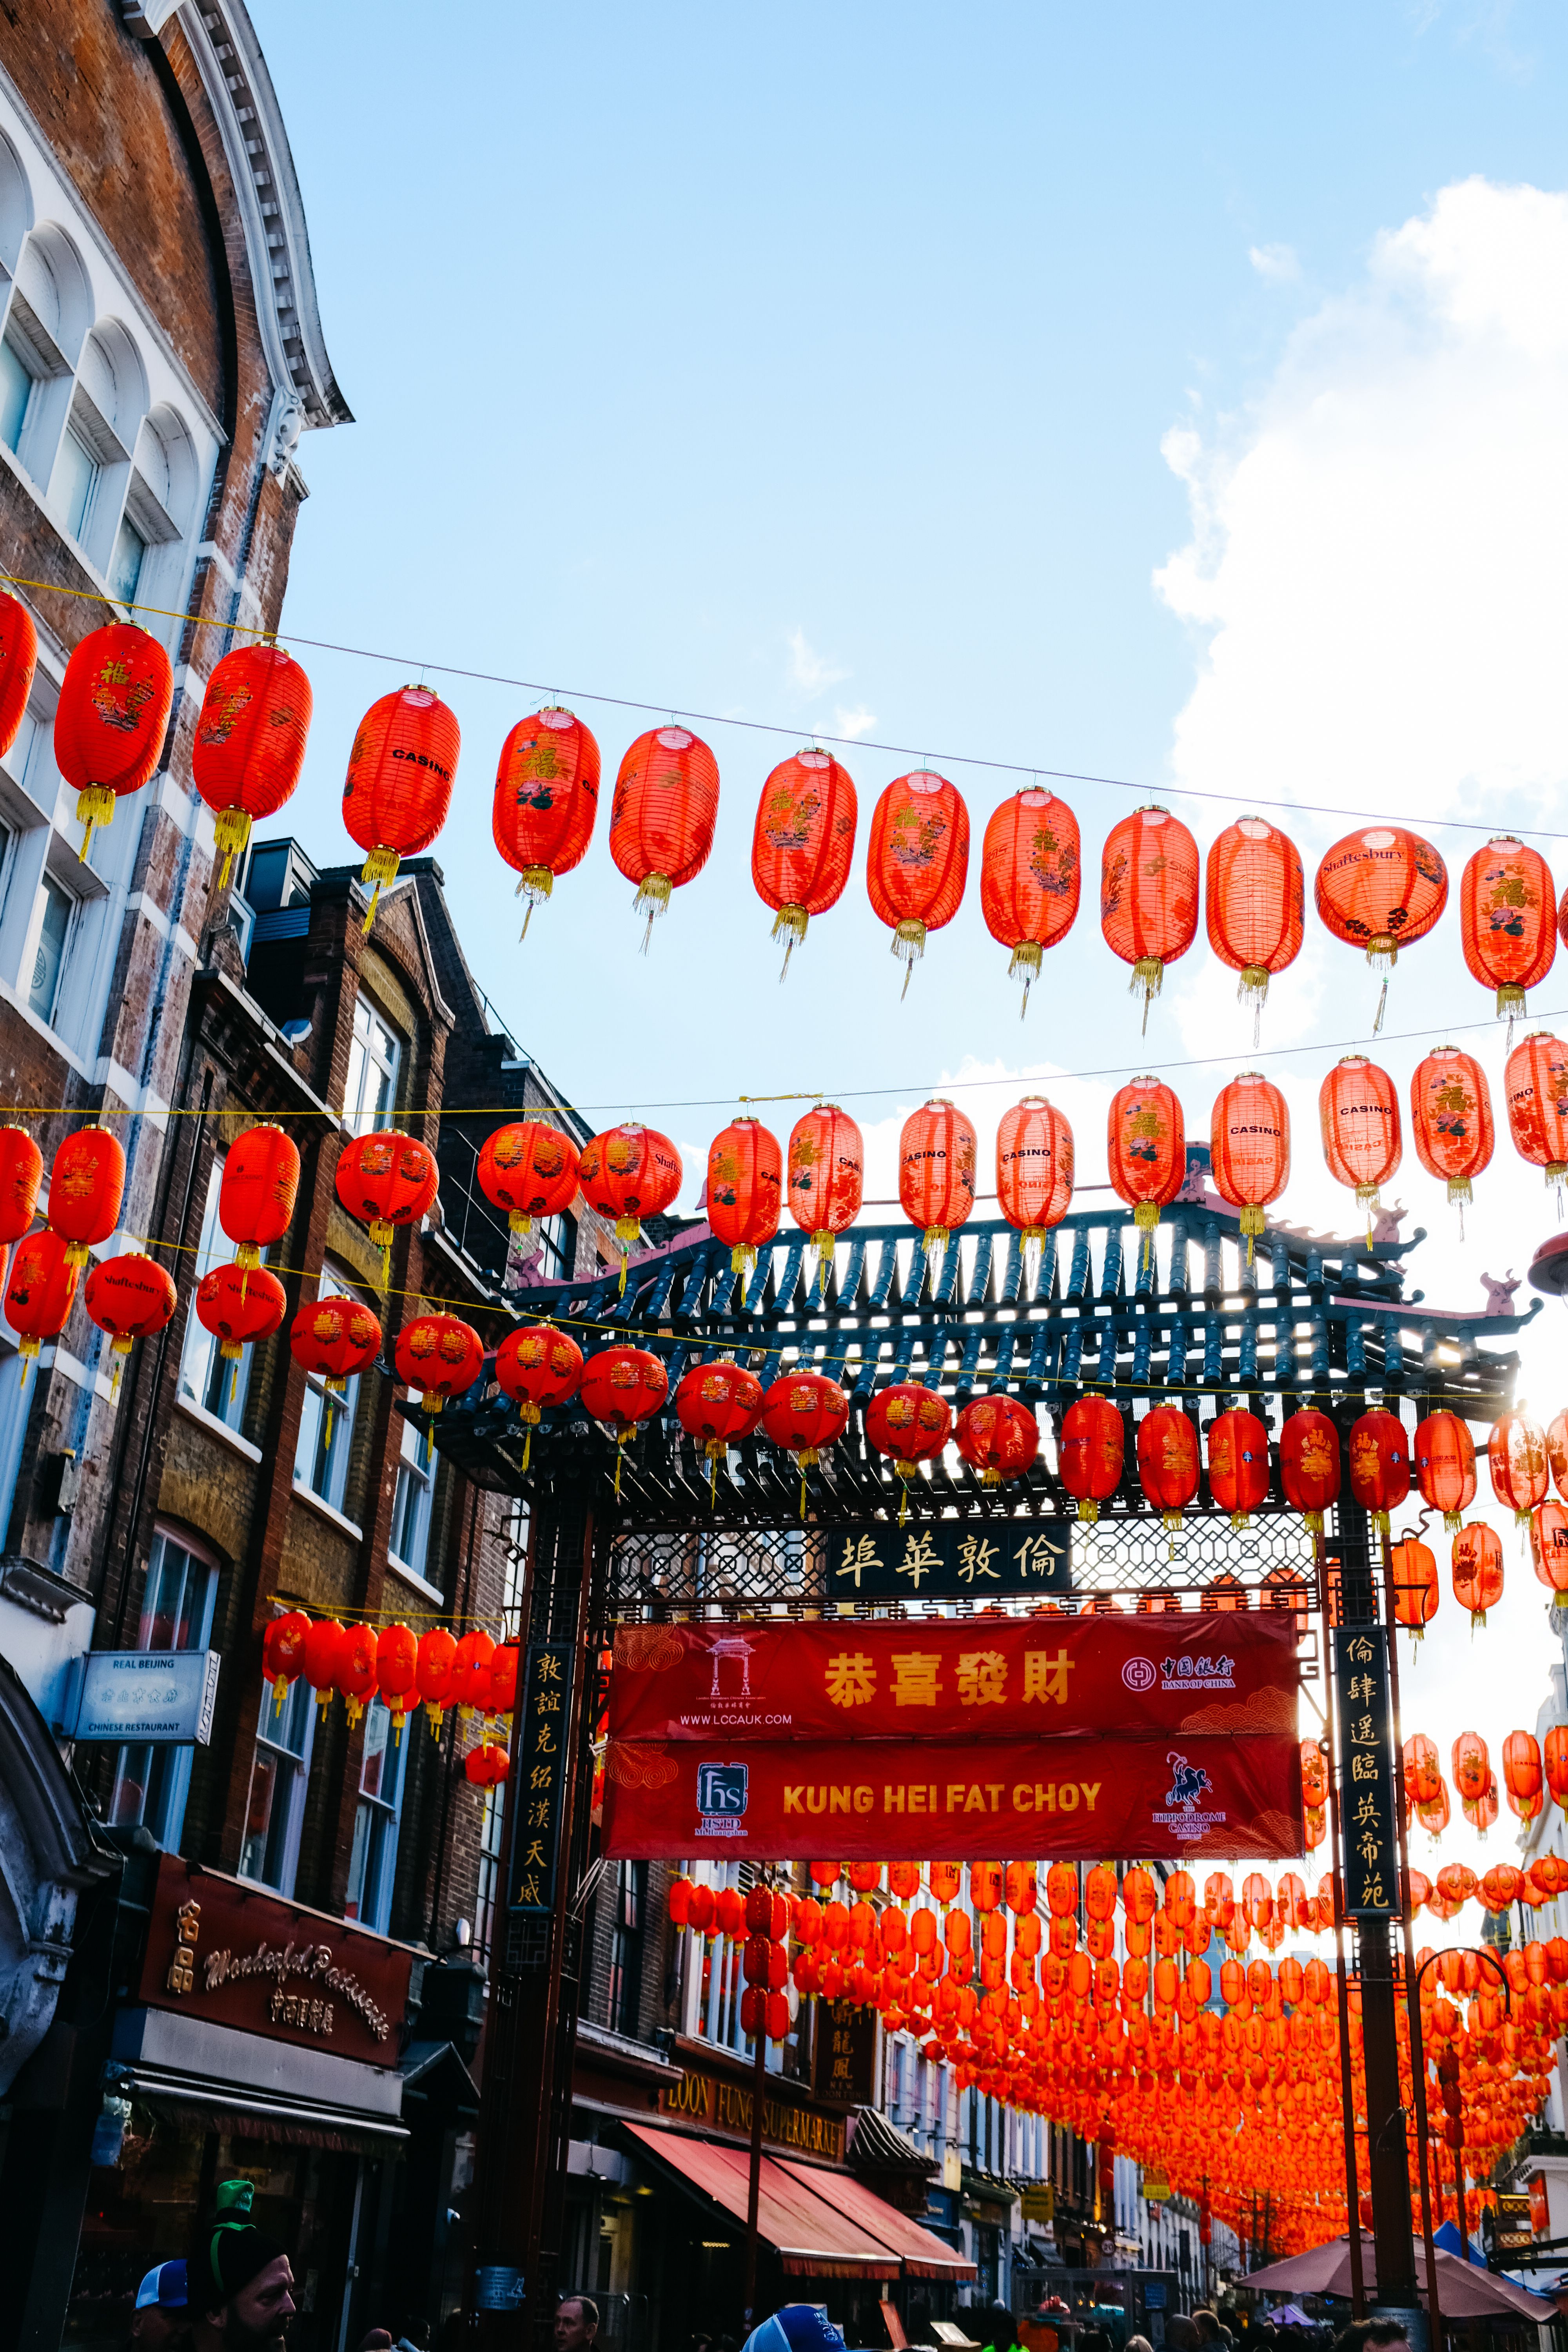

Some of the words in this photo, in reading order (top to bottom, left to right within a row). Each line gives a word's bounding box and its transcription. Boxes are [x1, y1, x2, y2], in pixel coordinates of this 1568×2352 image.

[101, 660, 130, 684] 福
[520, 748, 558, 779] 福
[1323, 848, 1405, 874] Shaftesbury
[1490, 877, 1528, 908] 福
[1435, 1085, 1467, 1112] 福
[1340, 1105, 1392, 1115] CASINO
[1129, 1112, 1160, 1138] 福
[1230, 1125, 1281, 1137] CASINO
[902, 1151, 946, 1165] CASINO
[1003, 1149, 1051, 1162] CASINO
[105, 1275, 161, 1294] Shaftesbury
[113, 1660, 136, 1669] REAL
[139, 1659, 174, 1669] BEIJING
[825, 1649, 1075, 1708] 恭喜發財
[1162, 1680, 1189, 1689] BANK
[1189, 1680, 1203, 1688] OF
[1203, 1679, 1236, 1688] CHINA
[680, 1714, 791, 1725] WWW.LCCAUK.COM
[89, 1722, 124, 1732] CHINESE
[125, 1722, 180, 1731] RESTAURANT
[784, 1785, 875, 1813] KUNG
[884, 1784, 937, 1813] HEI
[946, 1783, 1005, 1813] FAT
[1012, 1782, 1102, 1812] CHOY
[702, 1818, 740, 1829] HSTD
[1152, 1812, 1226, 1822] HIPPODROME
[1169, 1823, 1210, 1833] CASINO
[829, 2081, 853, 2090] NEW
[668, 2071, 710, 2118] LOON
[718, 2082, 753, 2130] FUNG
[762, 2099, 844, 2155] SUPERMARKET
